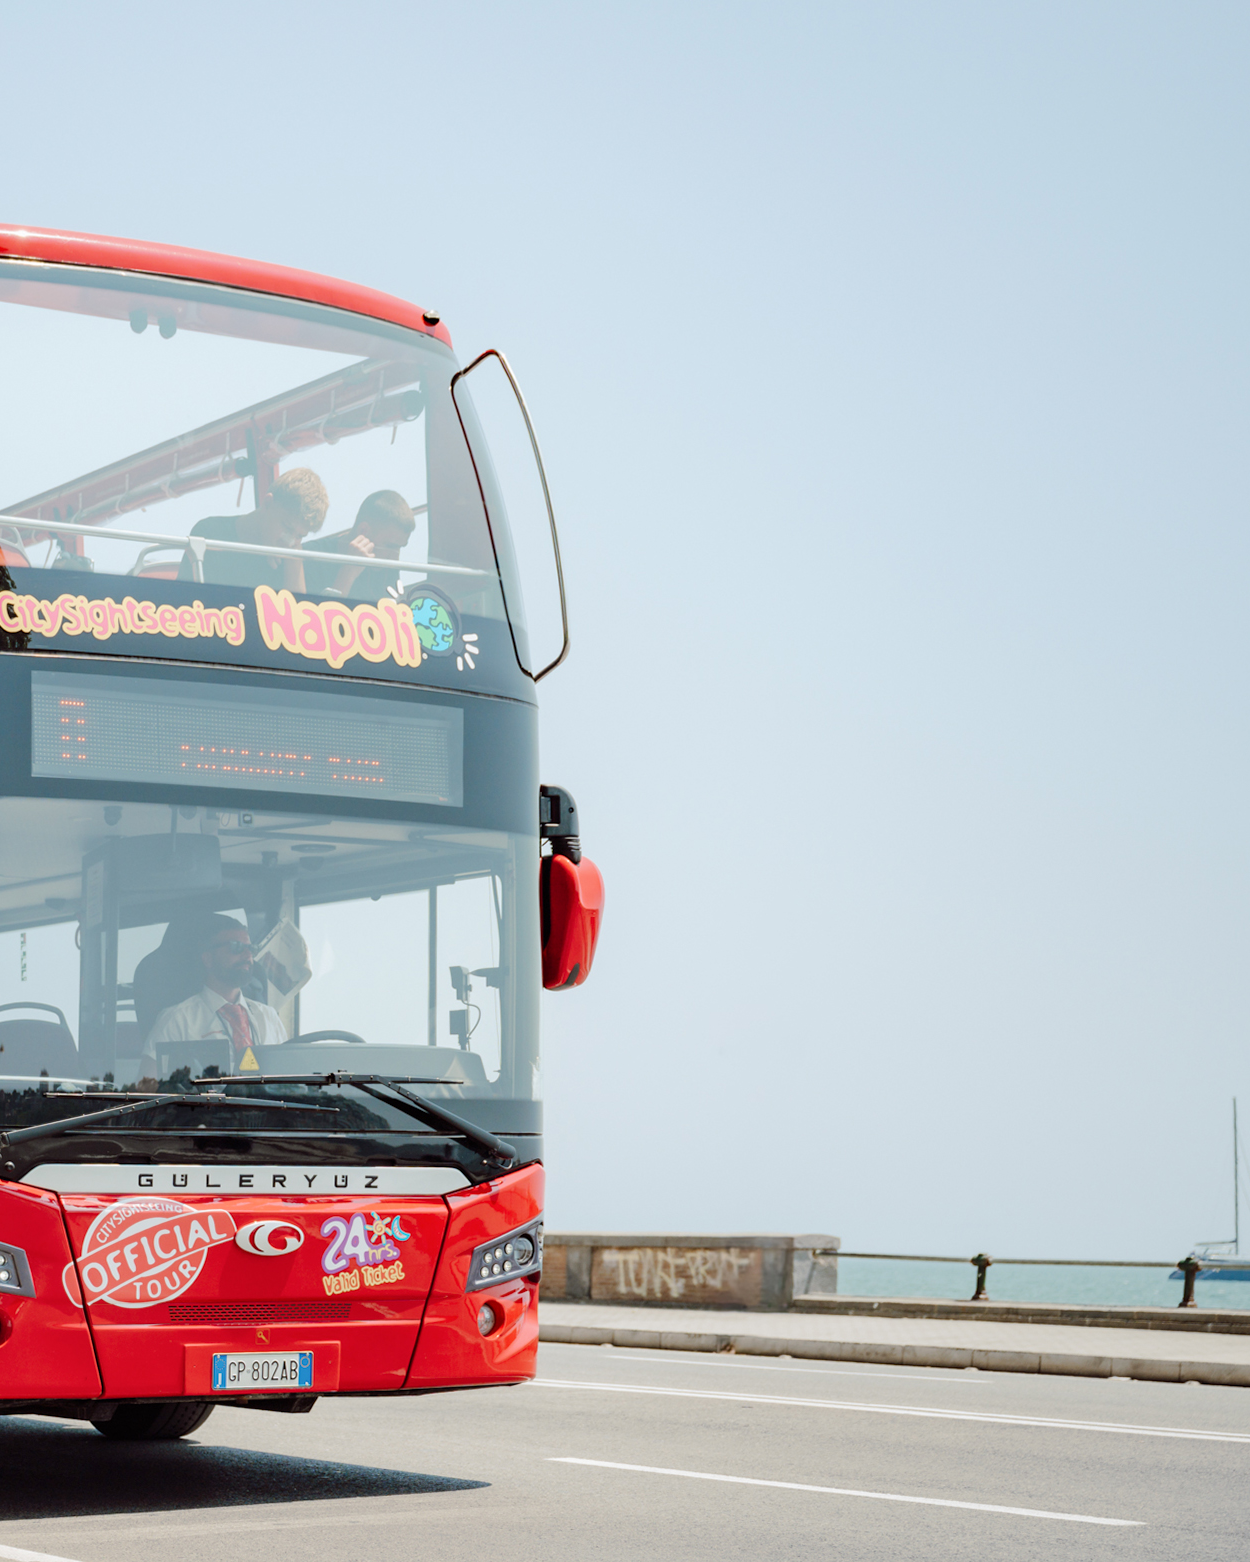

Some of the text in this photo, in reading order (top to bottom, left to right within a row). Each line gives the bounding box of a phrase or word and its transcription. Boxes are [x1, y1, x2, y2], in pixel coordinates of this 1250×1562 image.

[254, 585, 422, 670] Napoli
[137, 1173, 379, 1189] GÜLERYÜZ
[95, 1202, 184, 1245] CITYSIGHTSEEING
[321, 1213, 371, 1274] 24
[81, 1214, 228, 1294] OFFICIAL
[132, 1259, 198, 1301] TOUR
[322, 1261, 406, 1296] Valid Ticket
